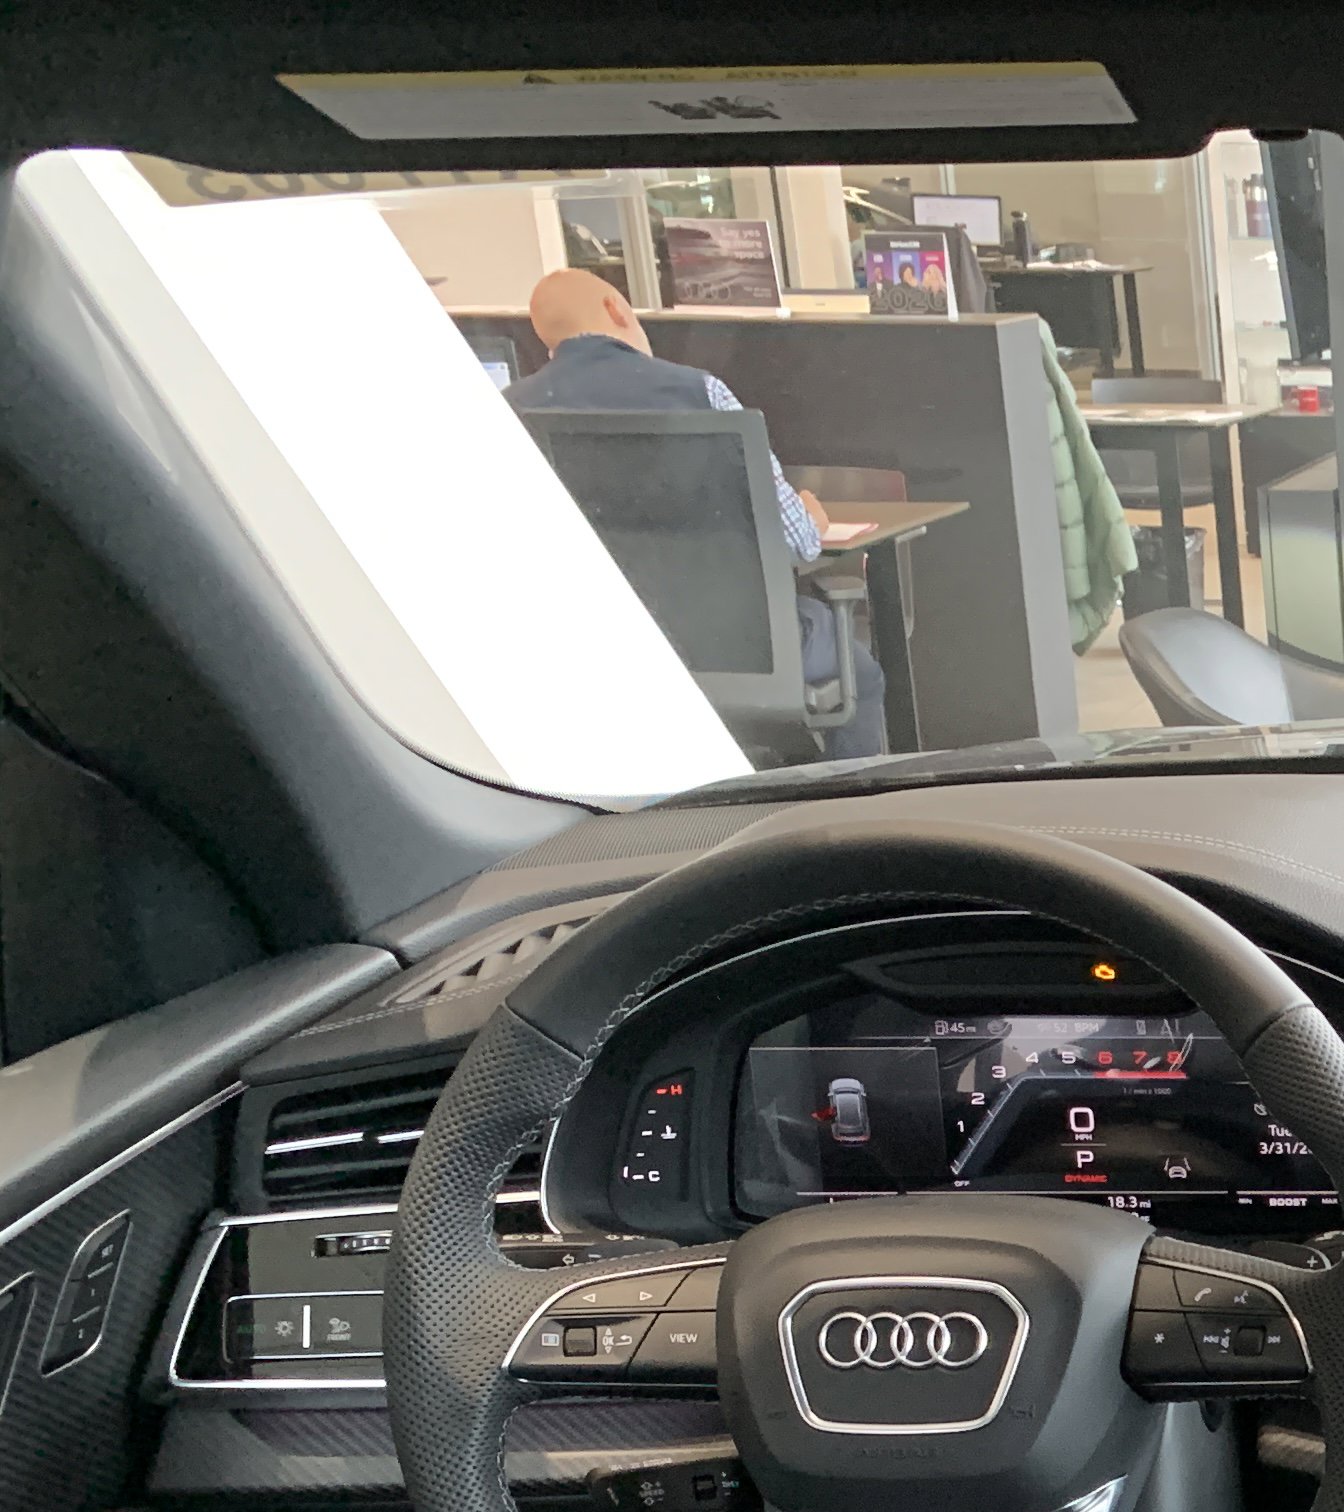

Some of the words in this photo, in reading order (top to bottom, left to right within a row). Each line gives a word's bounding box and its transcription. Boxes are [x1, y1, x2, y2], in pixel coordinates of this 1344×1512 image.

[949, 1023, 966, 1033] 45
[1074, 1022, 1099, 1033] BPM
[1025, 1052, 1039, 1064] 4
[1061, 1052, 1076, 1064] 5
[1098, 1051, 1113, 1064] 6
[1132, 1051, 1147, 1064] 7
[991, 1066, 1006, 1079] 3
[670, 1084, 682, 1095] H
[971, 1092, 986, 1105] 2
[1069, 1106, 1095, 1133] 0
[957, 1120, 965, 1132] 1
[1076, 1150, 1095, 1168] P
[648, 1170, 661, 1182] C
[1064, 1174, 1108, 1183] DYNAMIC
[1107, 1196, 1138, 1209] 18.3
[1269, 1198, 1308, 1207] BOOST
[602, 1335, 614, 1346] OK
[669, 1333, 698, 1343] VIEW
